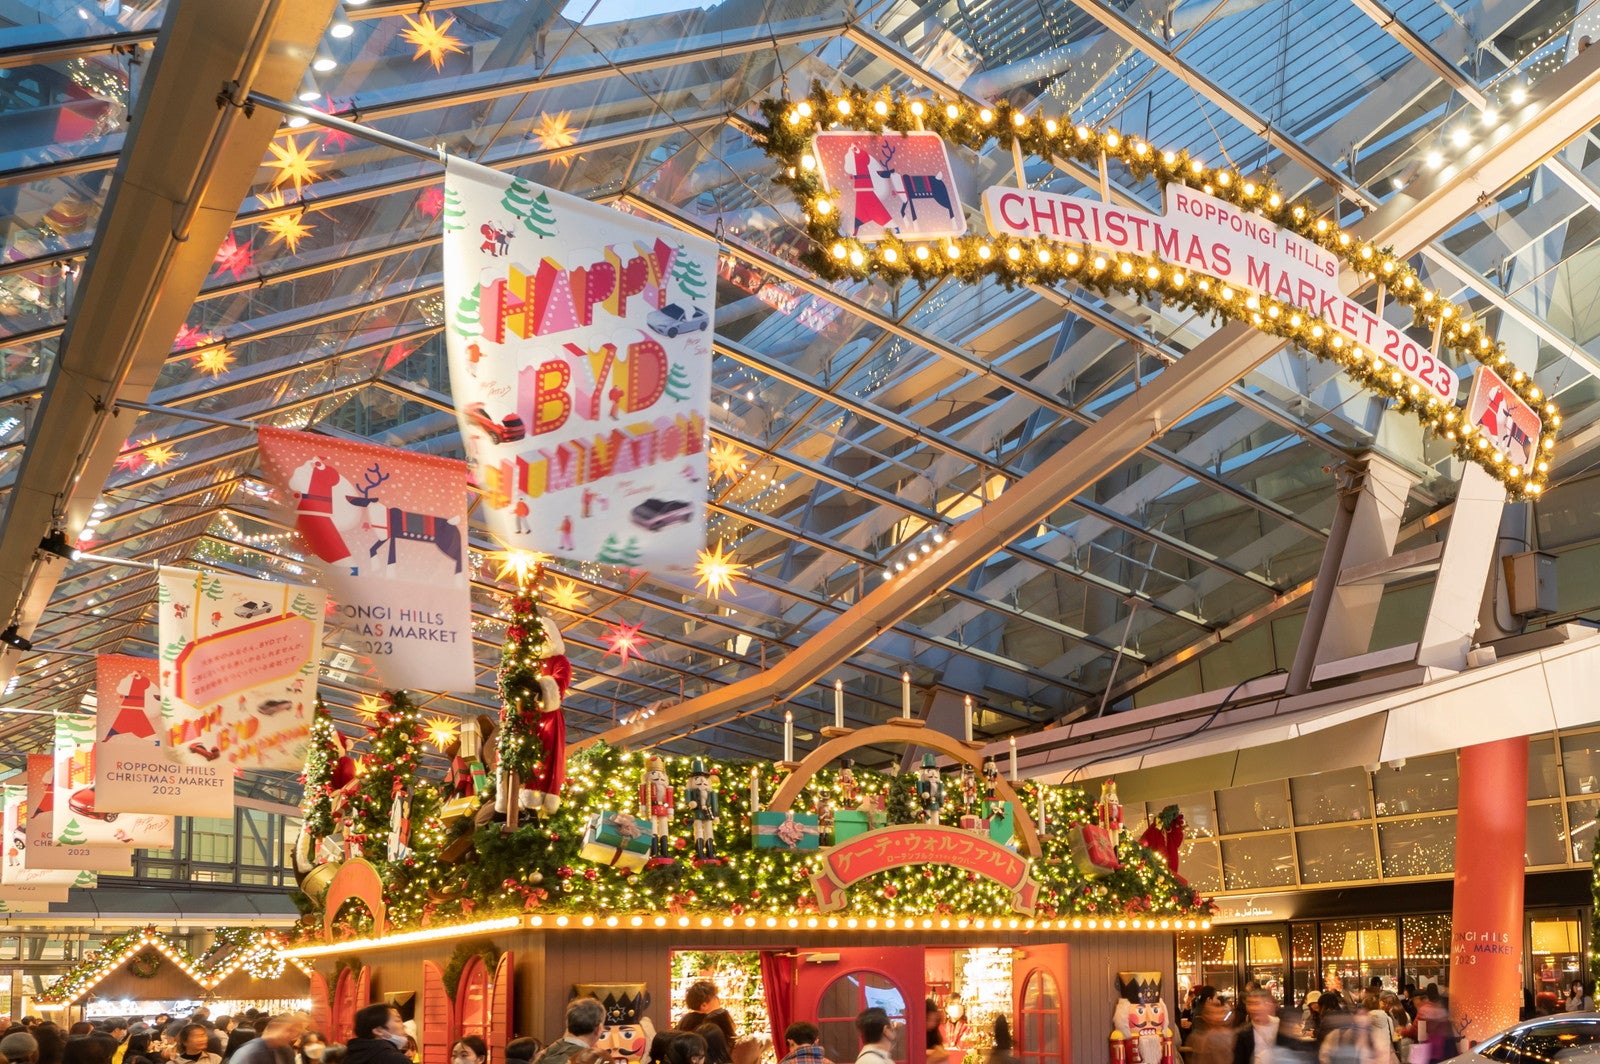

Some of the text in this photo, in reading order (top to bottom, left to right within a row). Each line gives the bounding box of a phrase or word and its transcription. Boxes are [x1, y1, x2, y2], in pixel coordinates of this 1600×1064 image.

[1176, 192, 1336, 279] ROPPONGI HILLS
[480, 237, 679, 345] HAPPY
[999, 192, 1452, 397] CHRISTMAS MARKET 2023
[517, 328, 669, 437] BYD
[482, 408, 705, 511] LLUMINATION
[337, 604, 444, 626] ONGI HILLS
[389, 624, 458, 643] MARKET
[116, 761, 216, 776] ROPPONGI HILLS
[106, 771, 225, 788] CHRISTMAS MARKET
[152, 785, 181, 796] 2023
[67, 848, 91, 856] 2023
[1480, 931, 1509, 943] HILLS
[1473, 944, 1514, 955] MARKET
[1455, 955, 1477, 966] 2023
